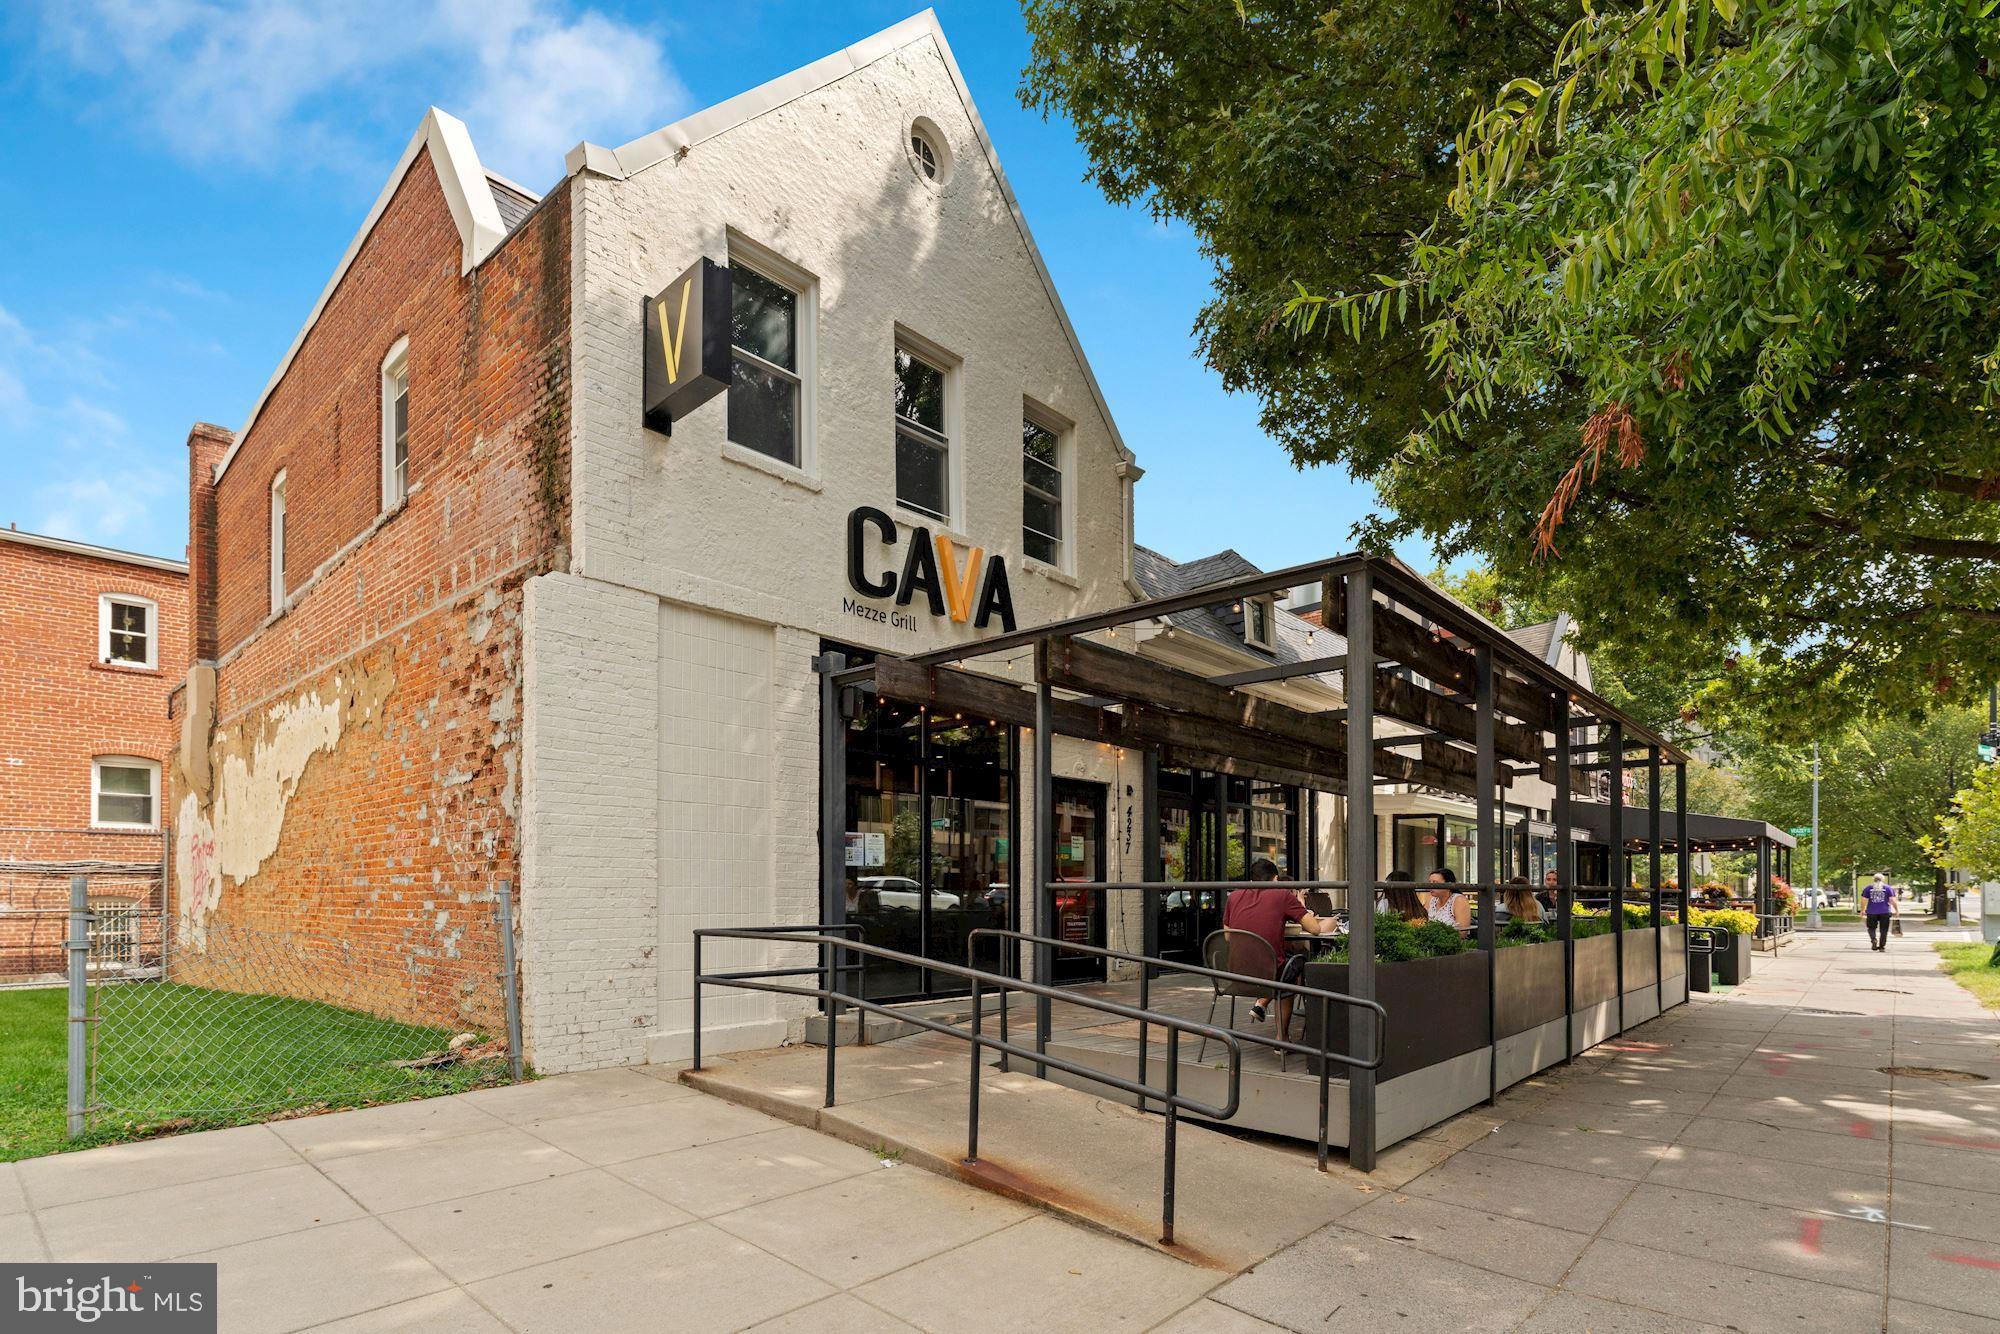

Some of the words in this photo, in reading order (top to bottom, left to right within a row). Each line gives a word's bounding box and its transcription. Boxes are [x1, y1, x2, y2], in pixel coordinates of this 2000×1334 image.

[658, 278, 692, 385] V
[843, 597, 887, 624] Mezze
[890, 611, 918, 633] Grill
[848, 506, 1017, 633] CAVA
